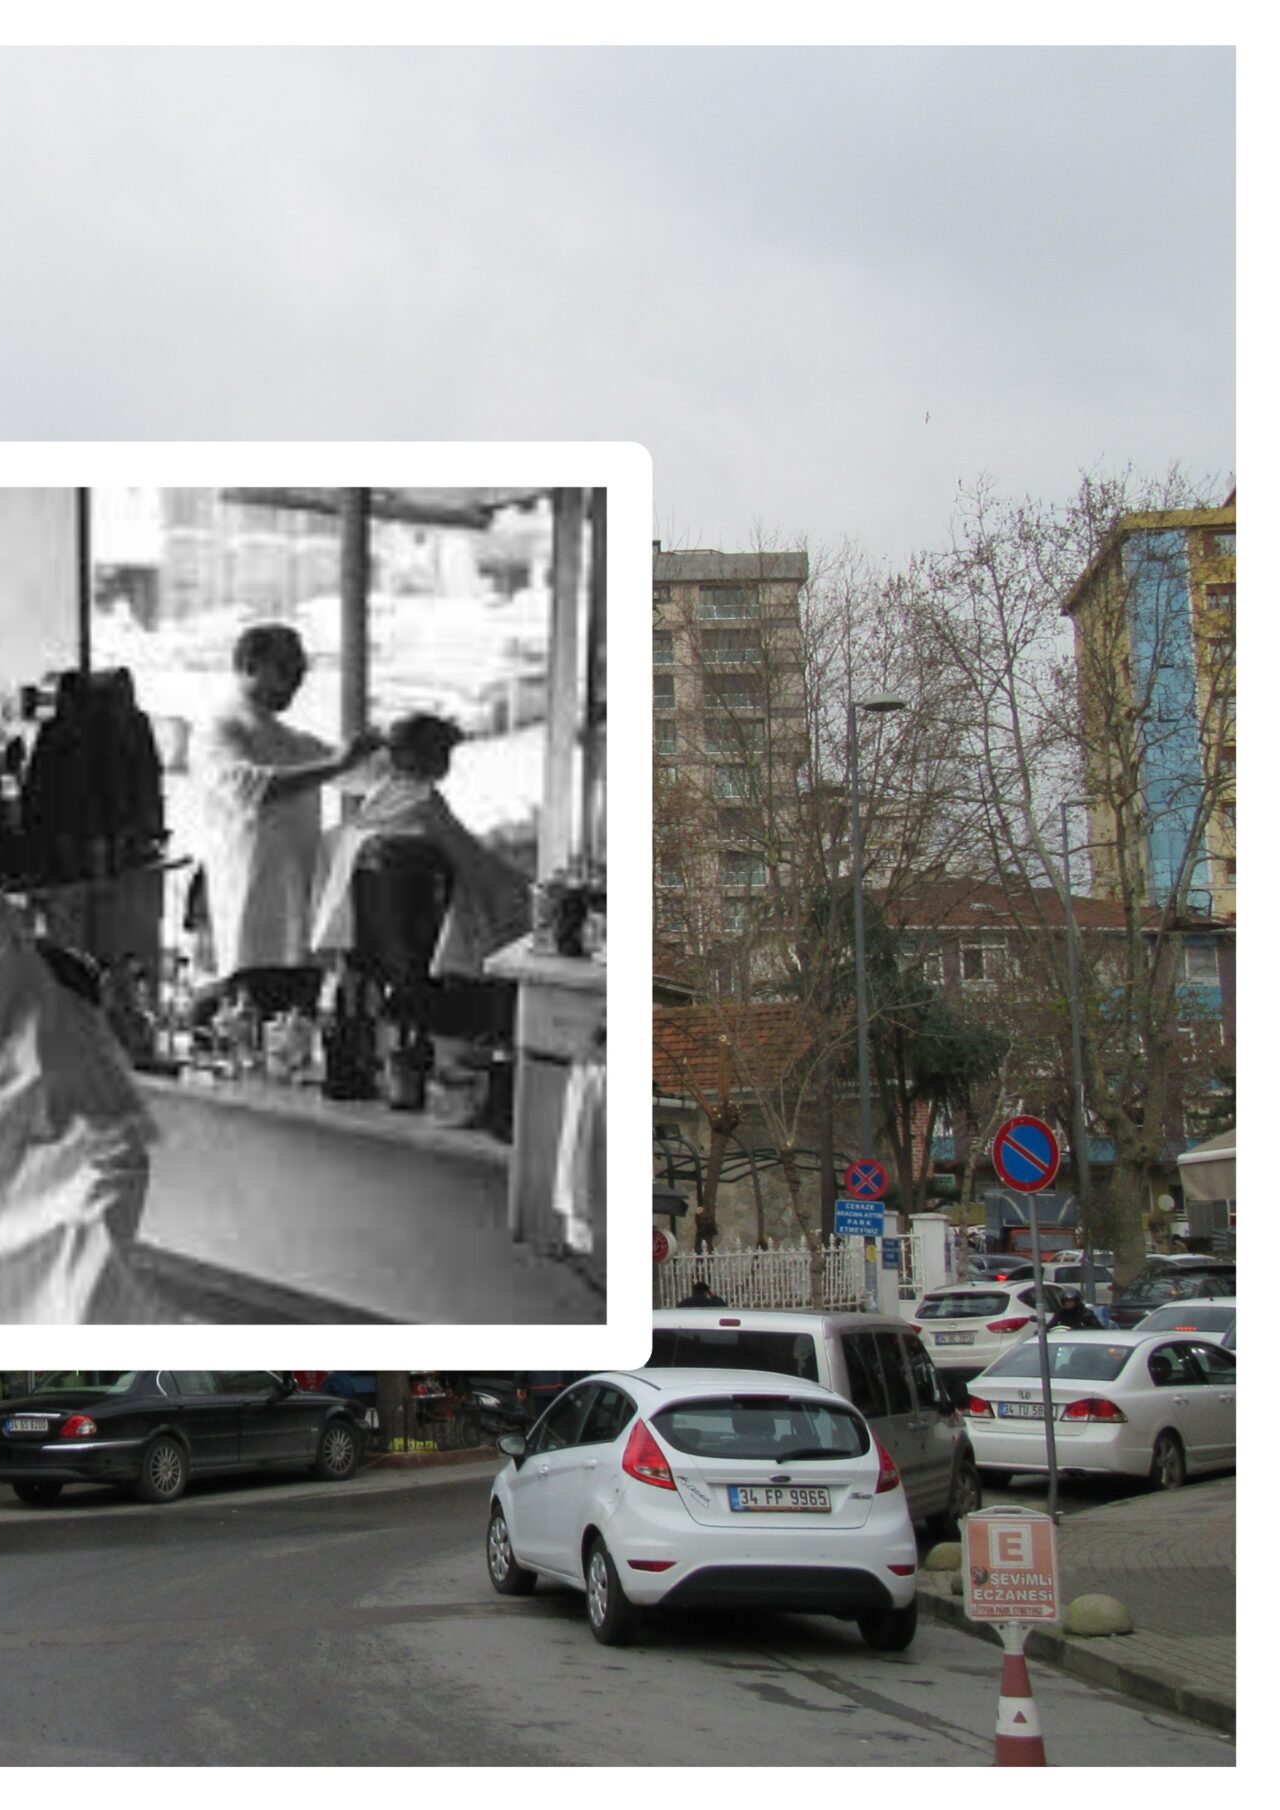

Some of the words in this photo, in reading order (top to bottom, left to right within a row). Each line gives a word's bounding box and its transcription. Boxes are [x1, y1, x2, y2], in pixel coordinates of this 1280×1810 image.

[847, 1218, 871, 1226] PARK
[1032, 1405, 1045, 1416] 58
[739, 1488, 759, 1505] 34
[765, 1489, 783, 1505] FP
[789, 1490, 827, 1506] 9965
[998, 1531, 1024, 1561] E
